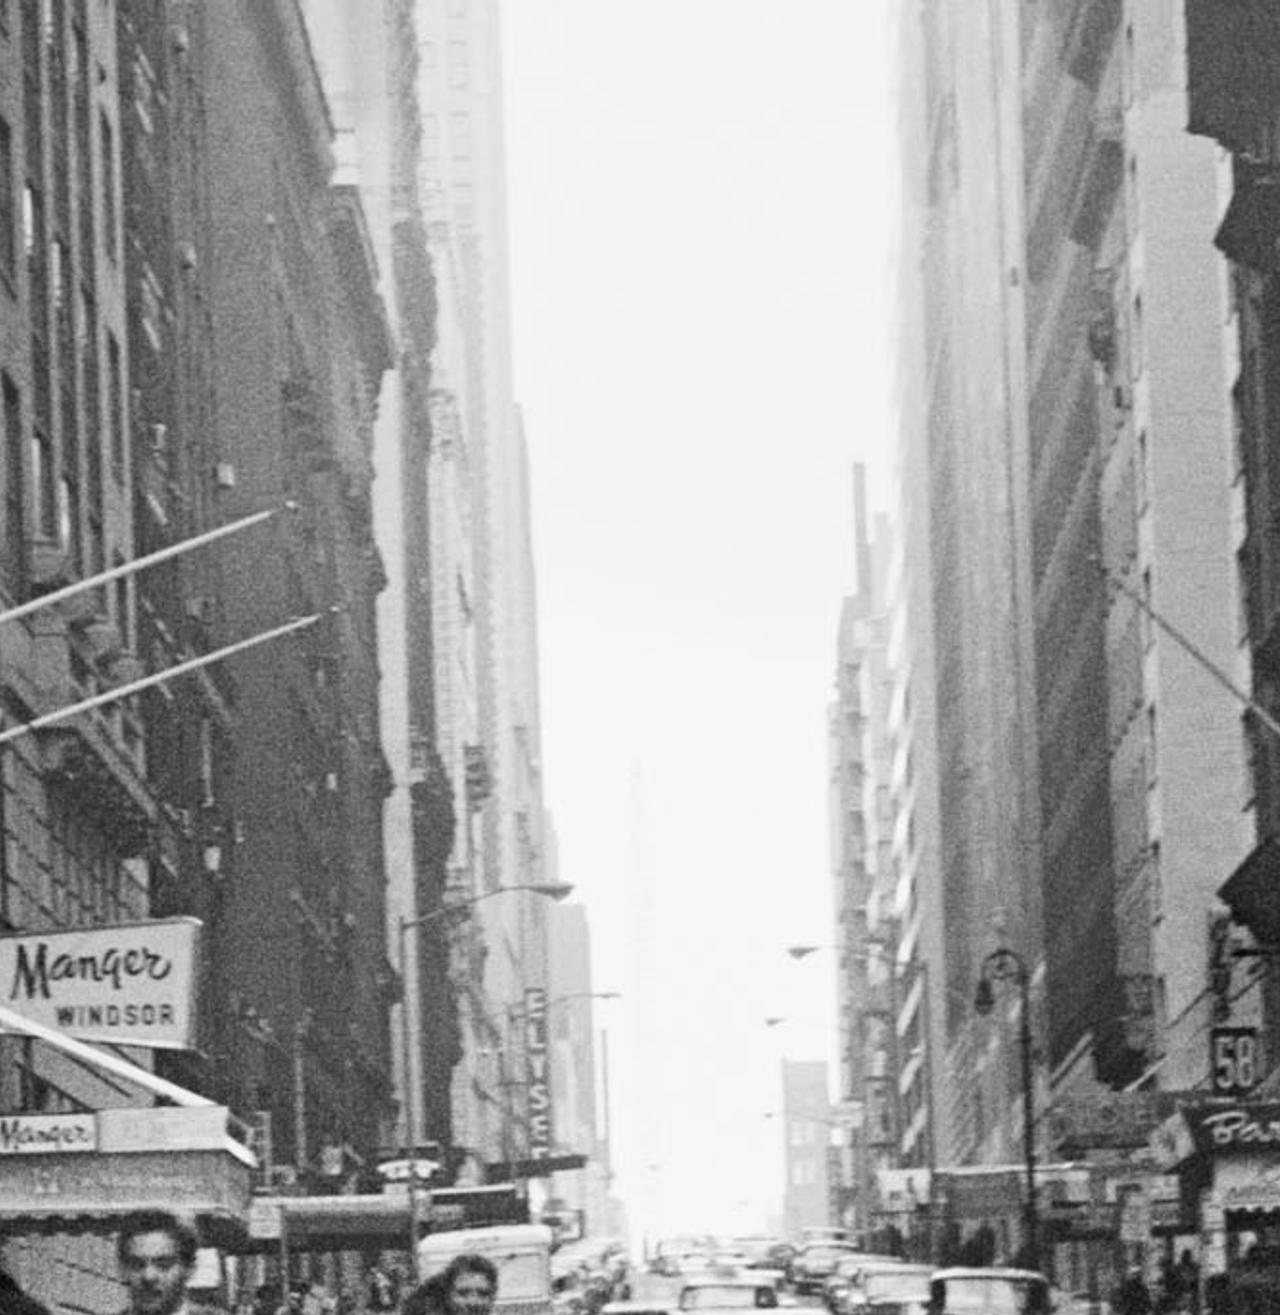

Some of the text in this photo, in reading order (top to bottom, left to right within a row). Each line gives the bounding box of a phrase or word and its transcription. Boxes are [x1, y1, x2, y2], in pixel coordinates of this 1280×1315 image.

[10, 943, 172, 999] Manger
[55, 1003, 173, 1026] WINDSOR
[1215, 1035, 1254, 1088] 58
